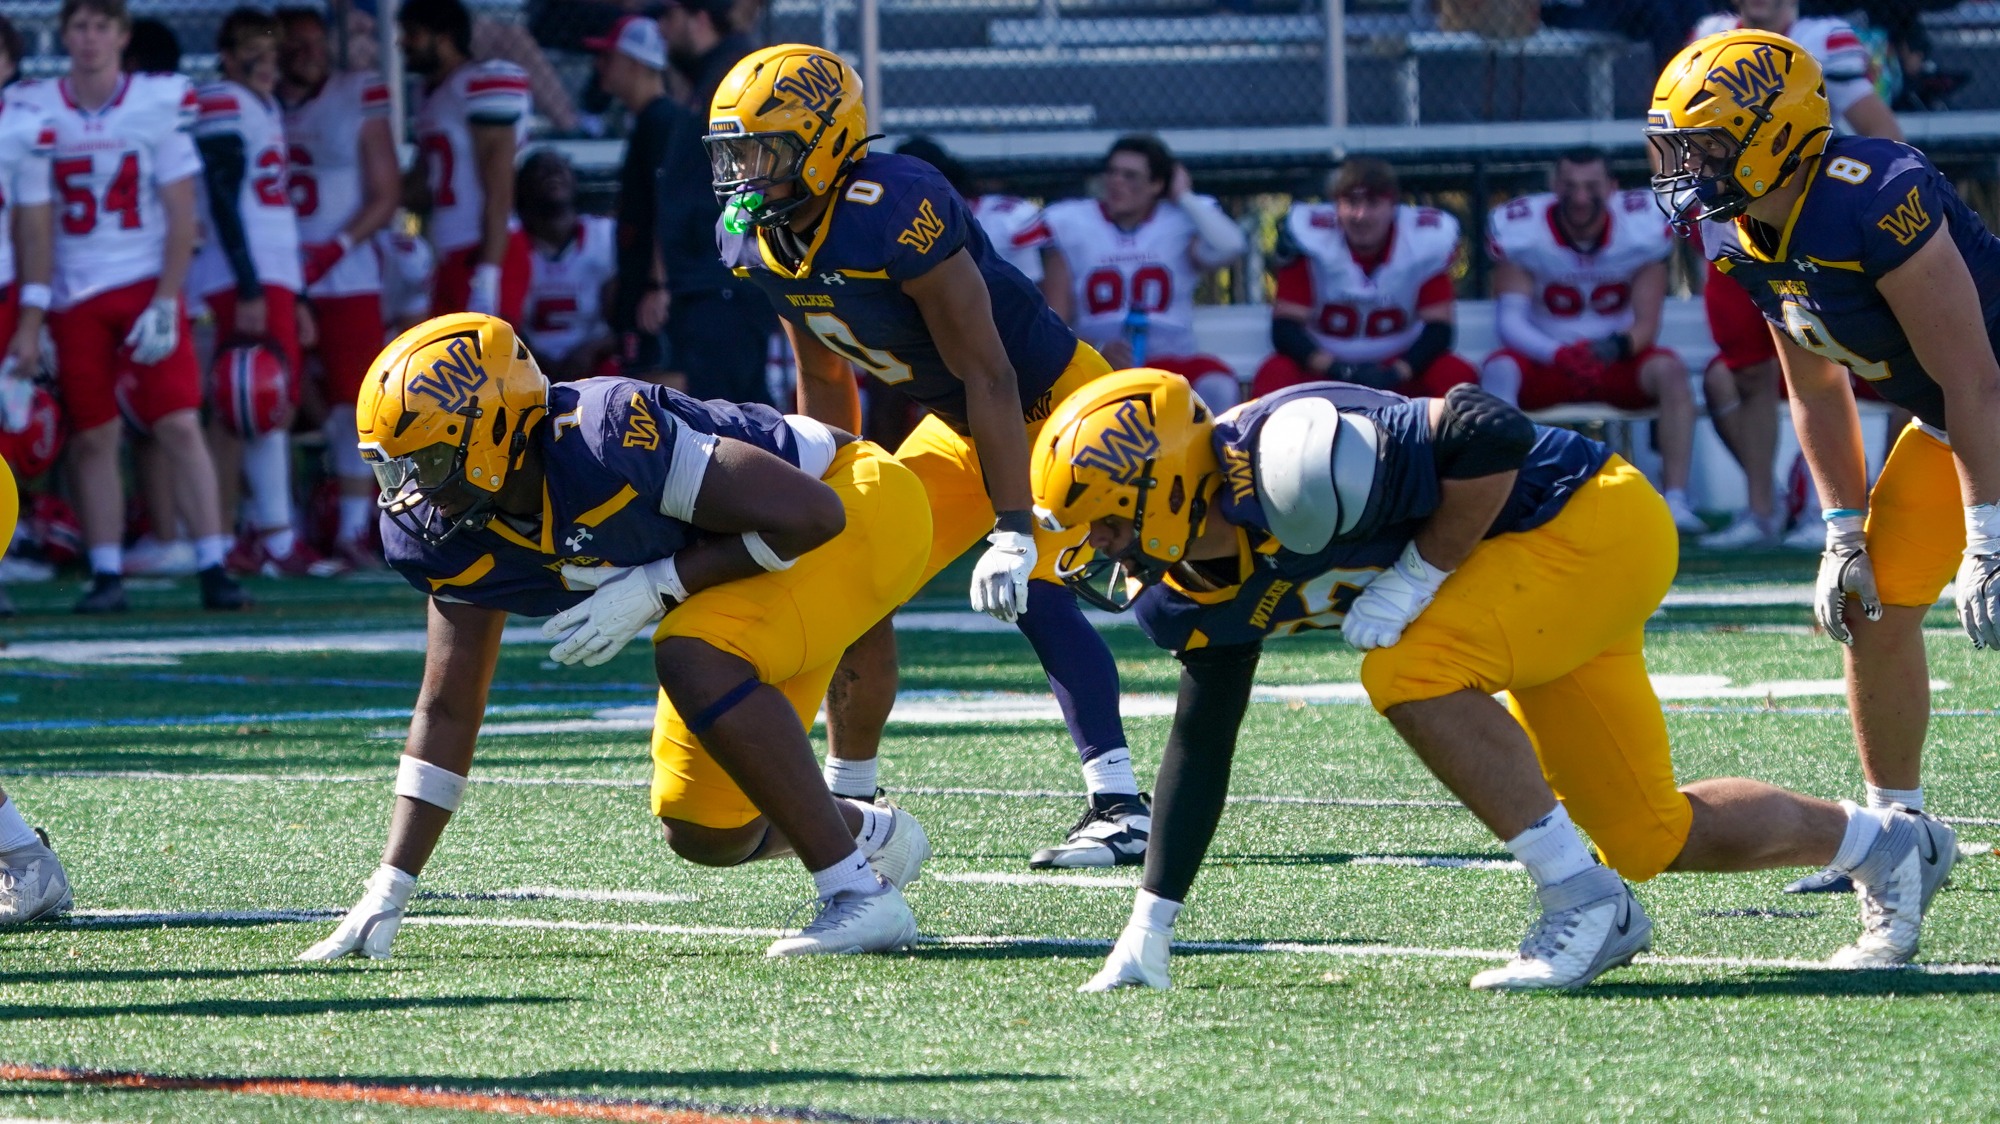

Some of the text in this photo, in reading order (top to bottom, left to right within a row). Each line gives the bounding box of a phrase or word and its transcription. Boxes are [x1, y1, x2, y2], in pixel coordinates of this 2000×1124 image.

[775, 54, 842, 112] W
[1706, 45, 1785, 108] W
[53, 151, 142, 235] 54
[845, 179, 884, 206] 0
[1826, 156, 1872, 185] 8
[897, 198, 945, 254] W
[1877, 186, 1931, 246] W
[785, 294, 835, 308] WILKES
[407, 337, 488, 414] W
[804, 312, 914, 386] 0
[622, 391, 661, 451] W
[1072, 400, 1160, 485] W
[1250, 579, 1294, 630] WILKES
